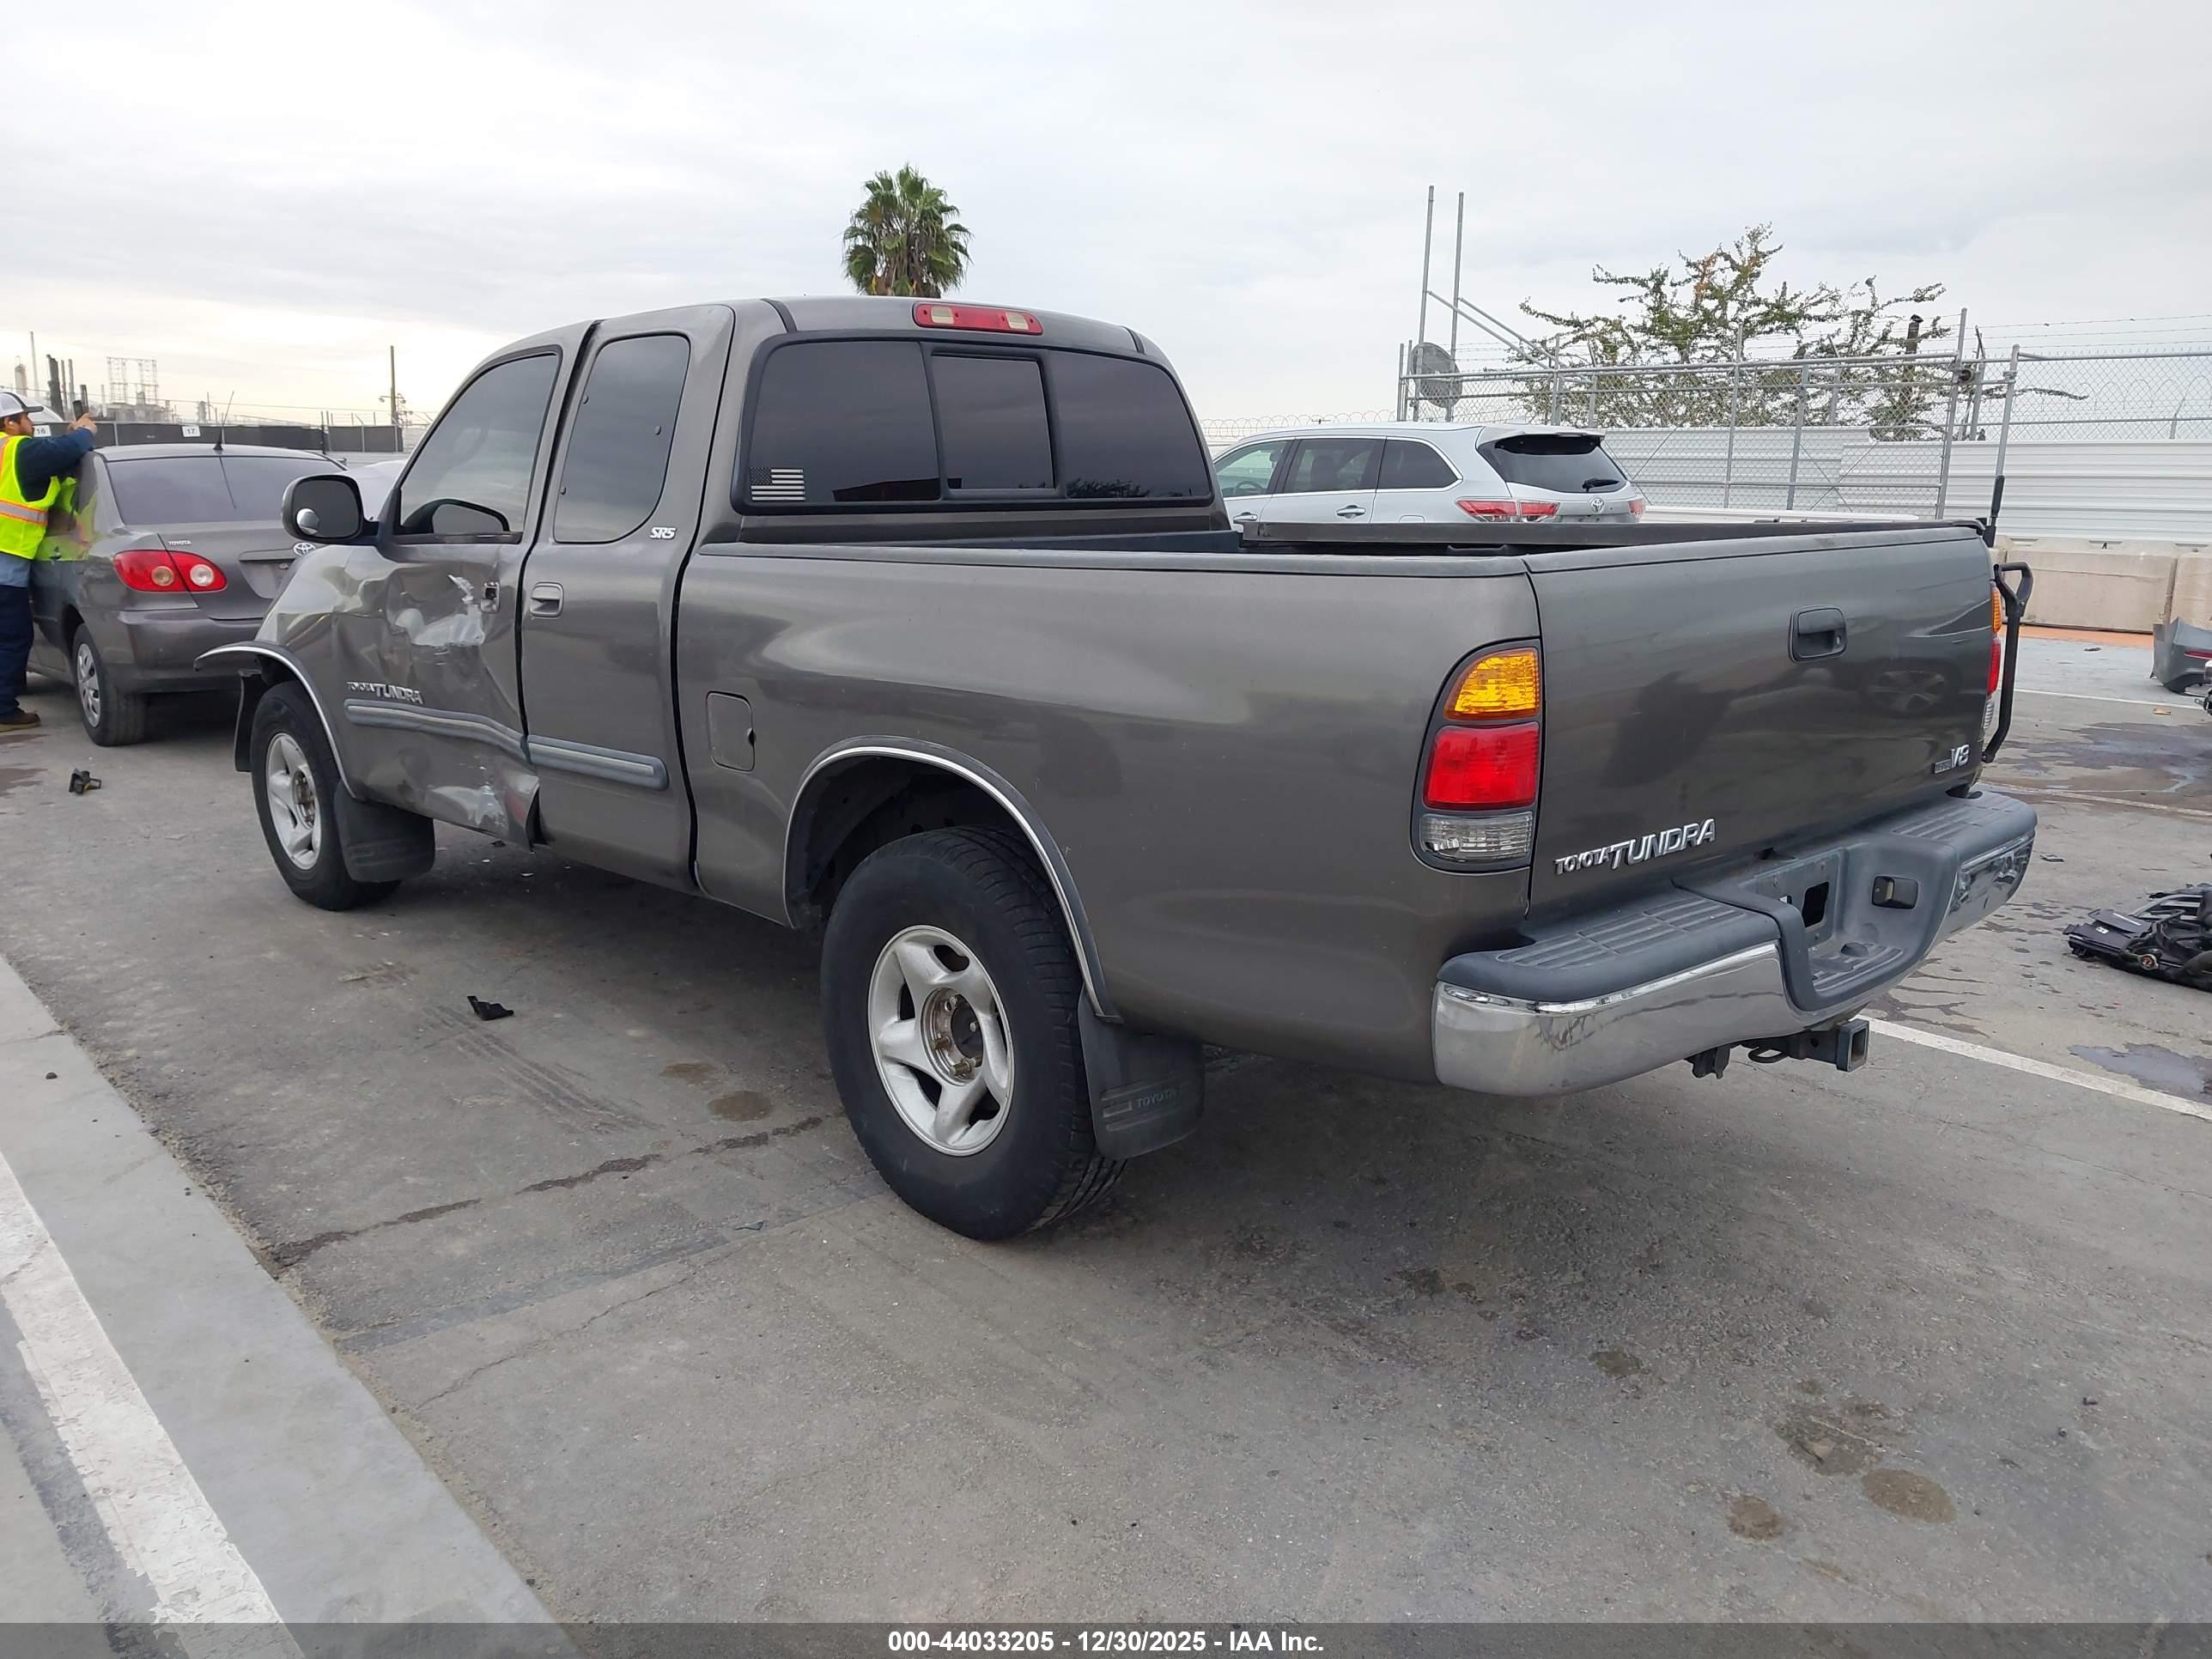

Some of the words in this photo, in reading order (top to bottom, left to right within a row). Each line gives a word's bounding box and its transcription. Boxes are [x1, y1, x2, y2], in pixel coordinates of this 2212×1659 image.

[649, 526, 677, 539] SR5
[373, 683, 424, 704] TUNDRA
[1950, 744, 1970, 769] V8
[1553, 847, 1610, 875] TOYOTA
[1607, 817, 1716, 870] TUNDRA
